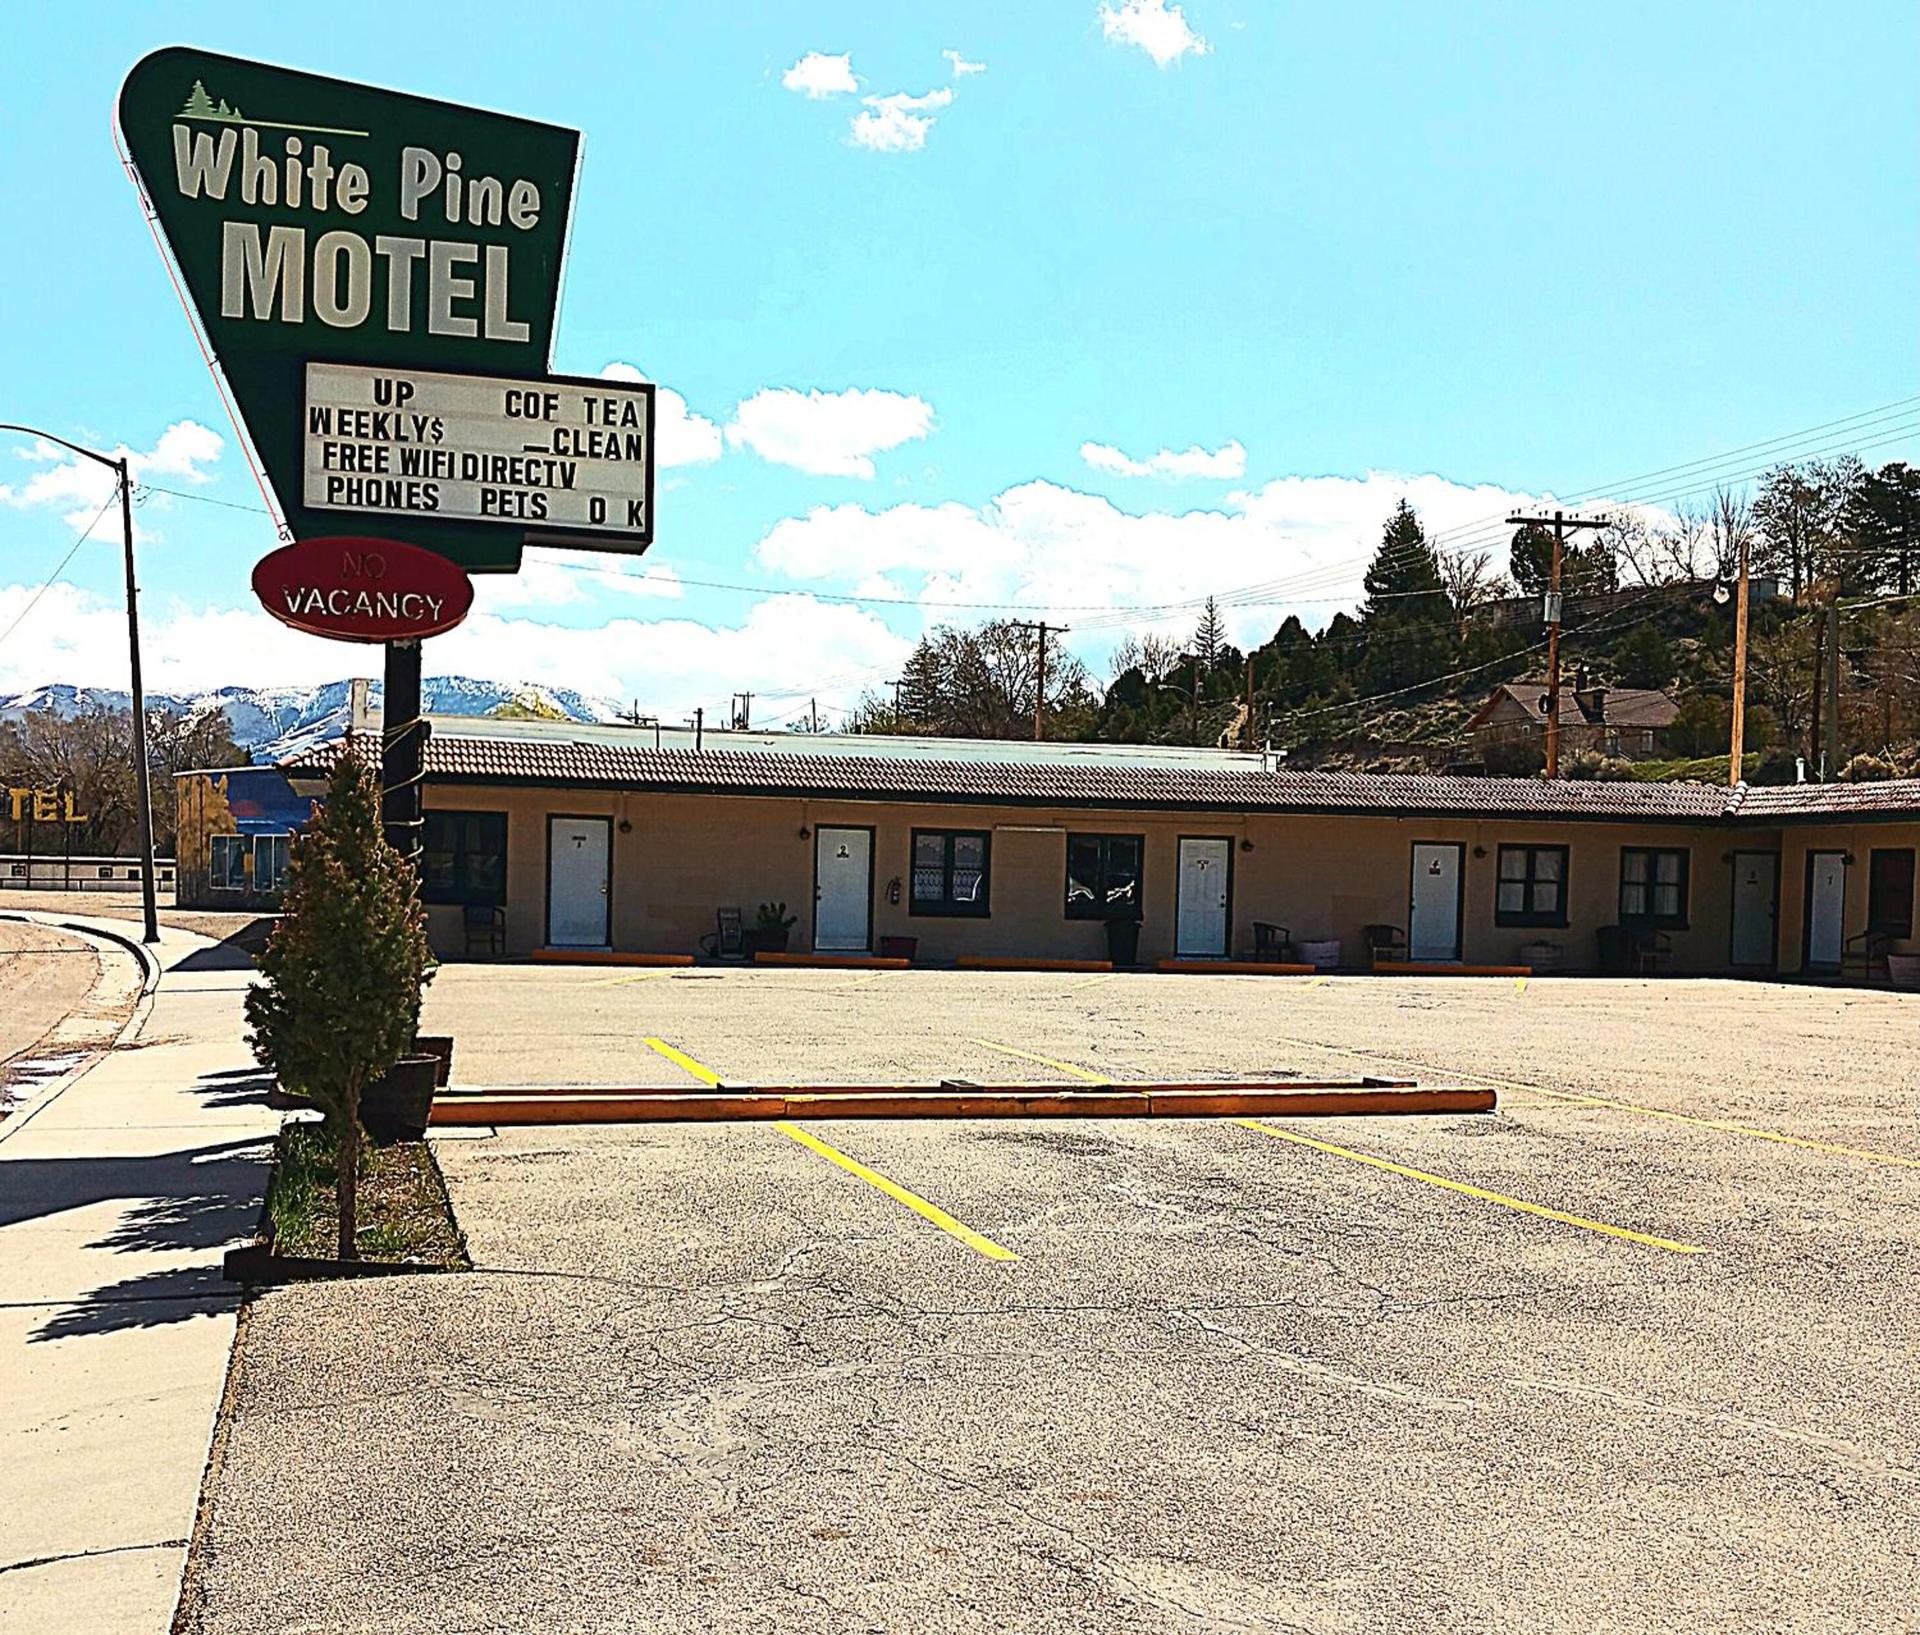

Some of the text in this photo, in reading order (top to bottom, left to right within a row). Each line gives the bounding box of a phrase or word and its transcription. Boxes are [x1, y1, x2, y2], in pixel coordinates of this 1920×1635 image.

[172, 123, 541, 230] White Pine
[220, 221, 531, 342] MOTEL
[374, 378, 638, 428] UP COF TEA
[323, 441, 577, 490] FREE WIFI DIRECTV
[327, 476, 440, 511] PHONES
[481, 487, 547, 519] PETS
[341, 552, 386, 579] NO
[283, 586, 446, 621] VACANCY
